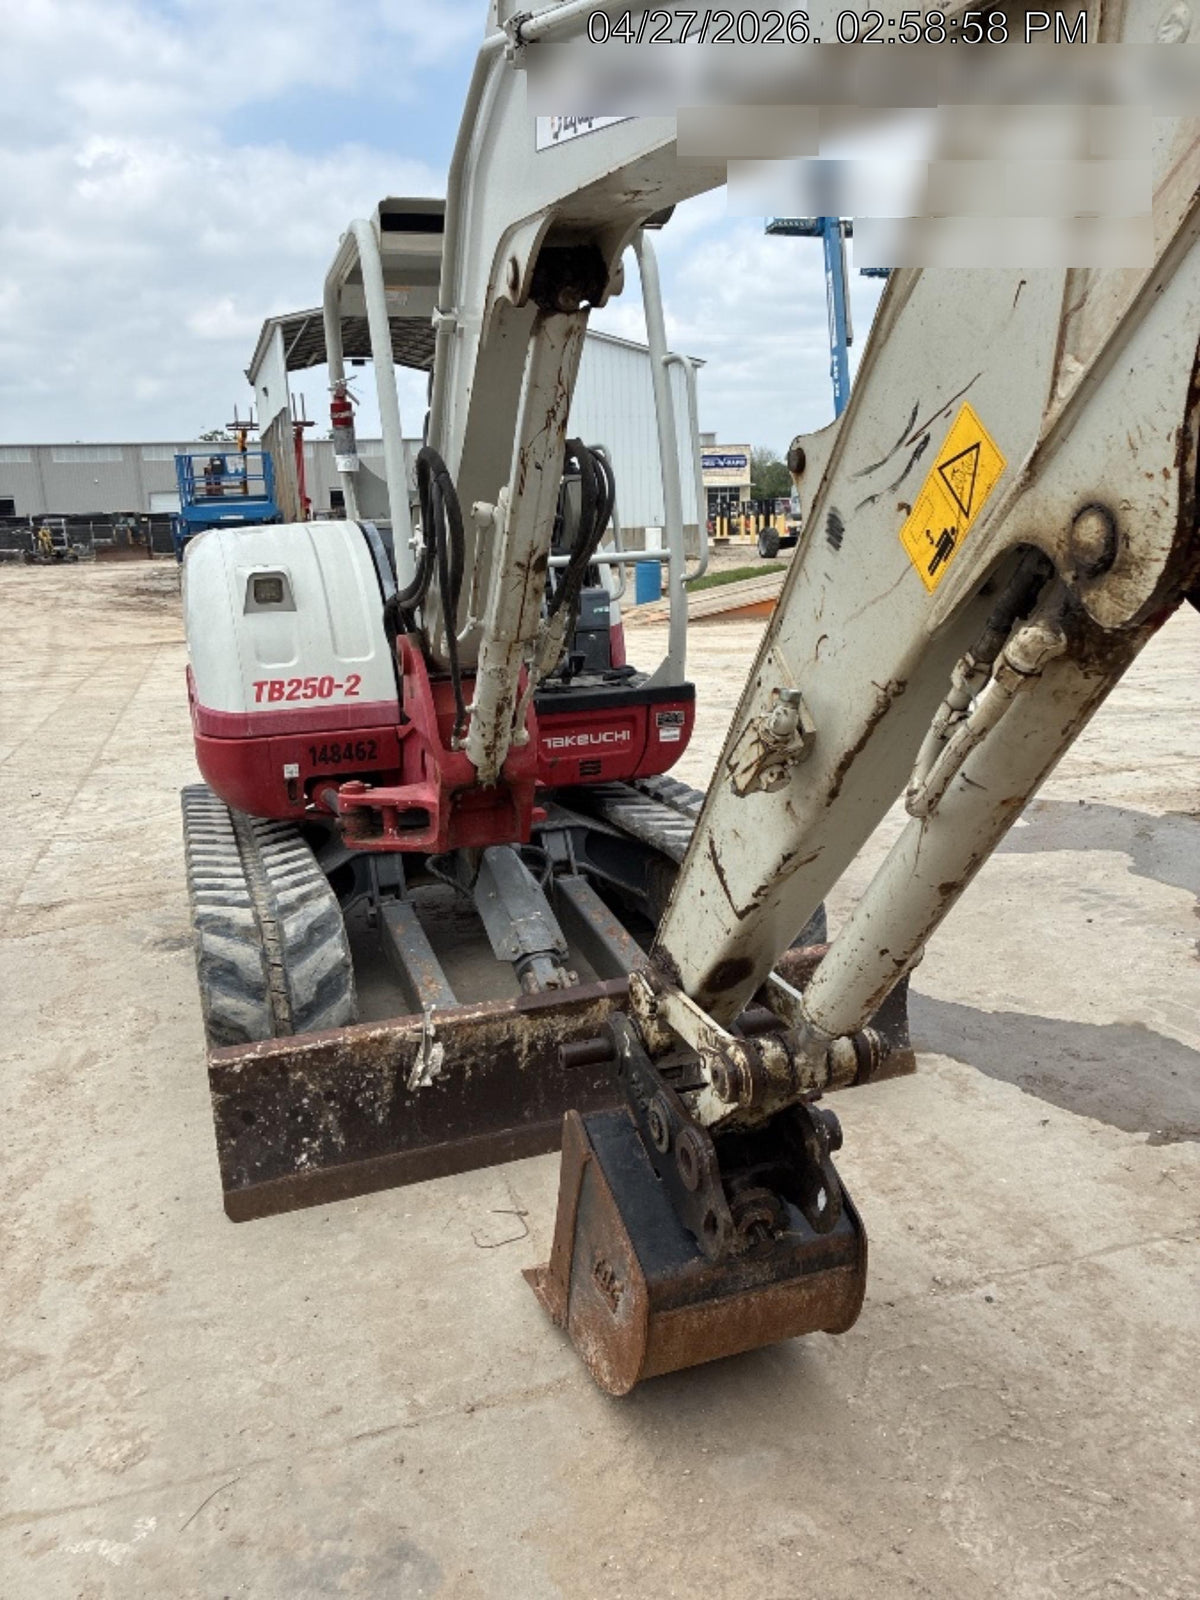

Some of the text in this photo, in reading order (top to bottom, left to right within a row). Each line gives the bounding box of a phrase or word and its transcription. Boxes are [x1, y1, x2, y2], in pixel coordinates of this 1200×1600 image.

[252, 674, 362, 703] TB250-2
[308, 739, 378, 767] 148462
[542, 730, 631, 749] TAKEUCHI
